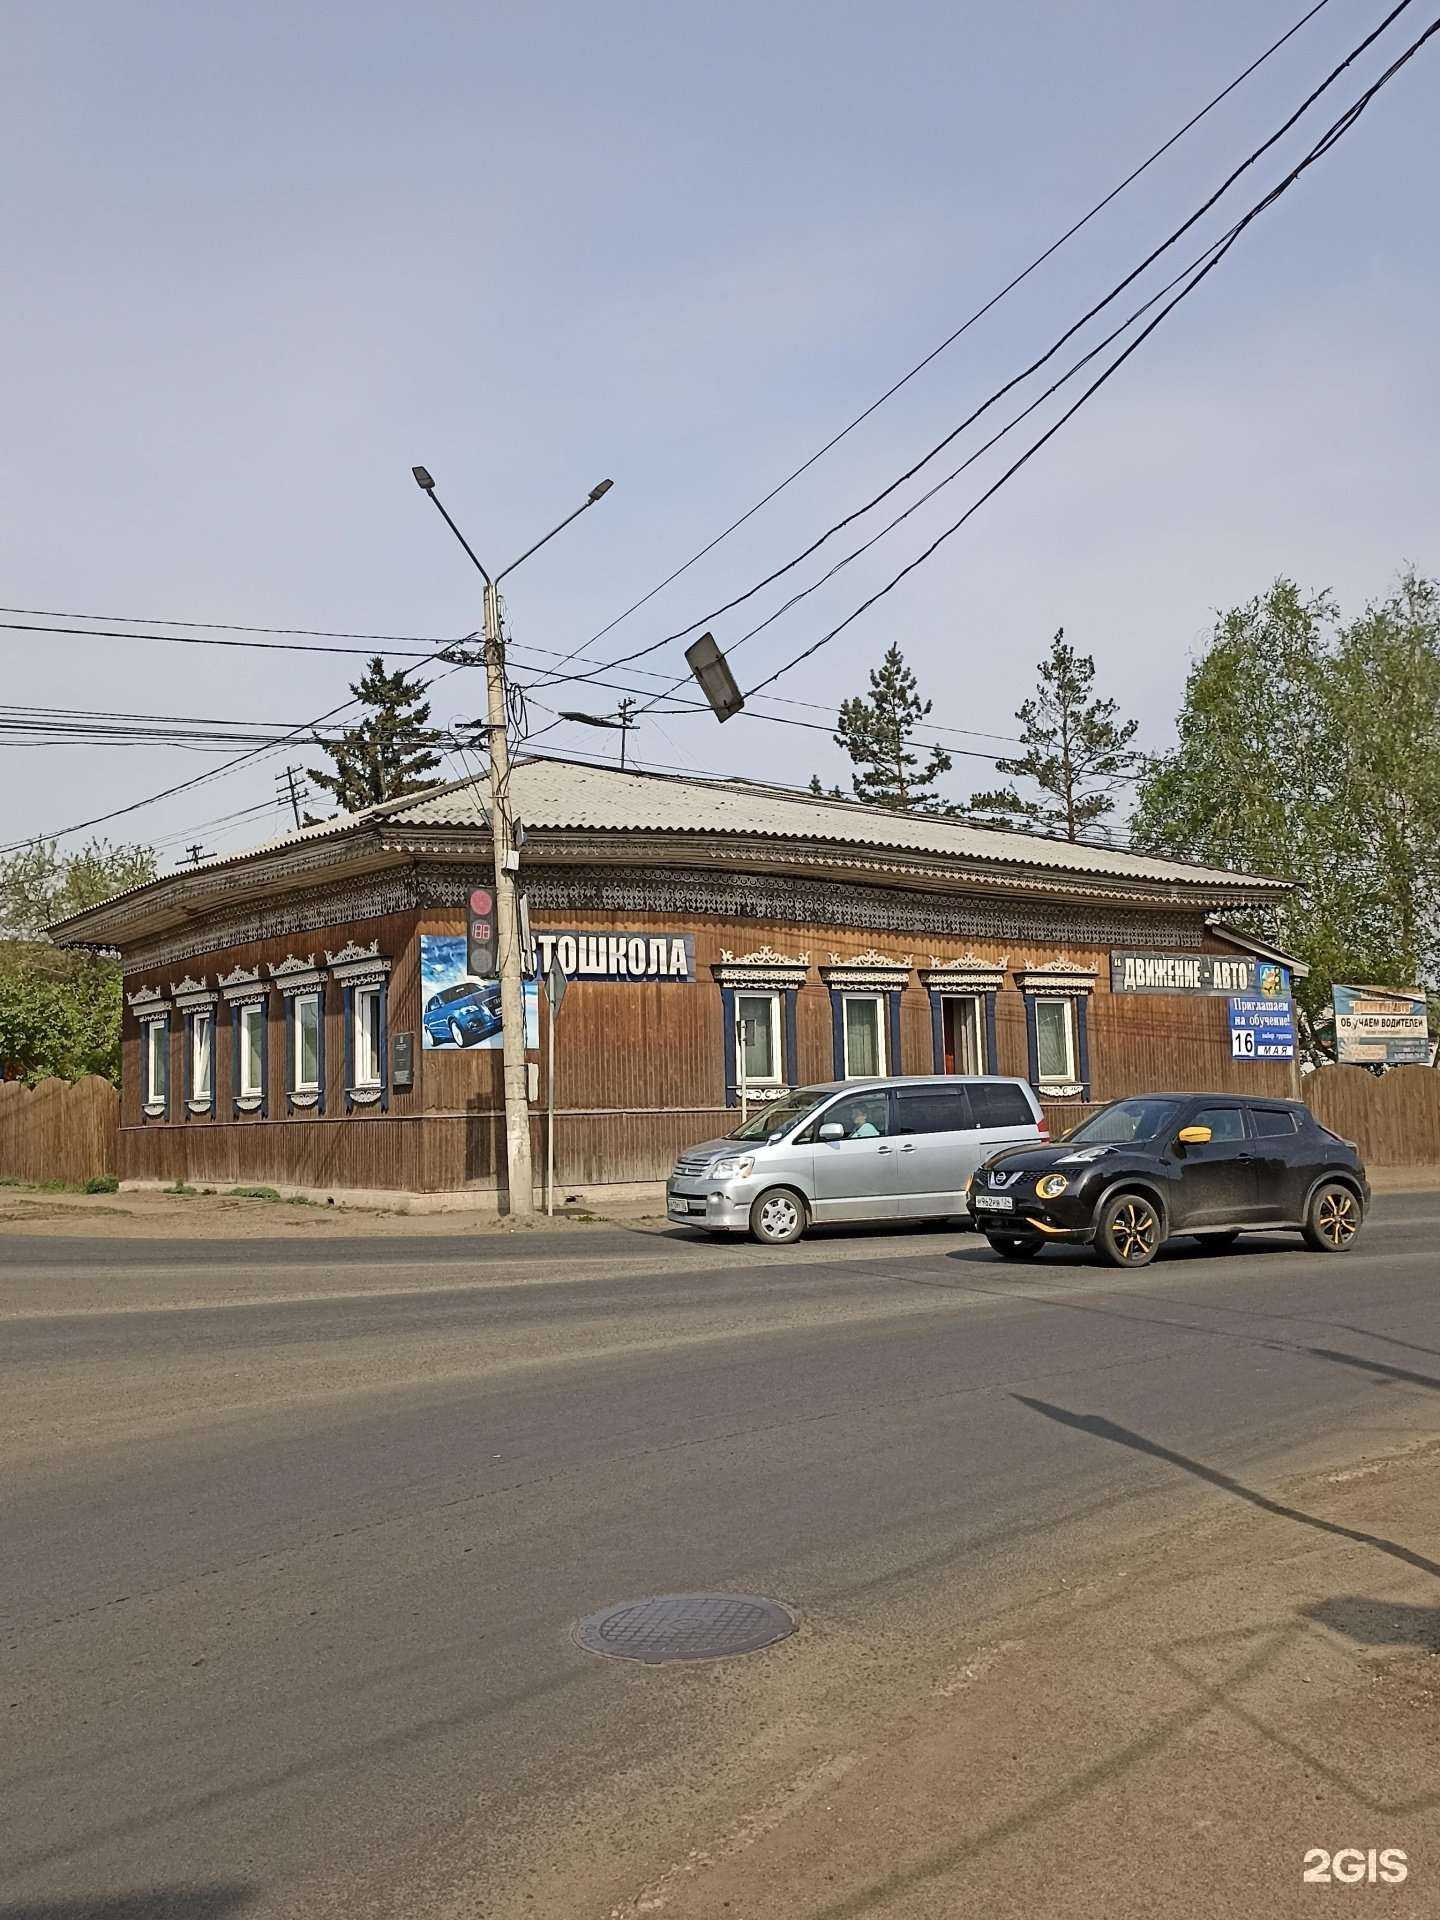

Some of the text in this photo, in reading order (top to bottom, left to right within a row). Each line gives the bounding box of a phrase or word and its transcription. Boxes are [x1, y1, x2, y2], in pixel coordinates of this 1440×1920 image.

[496, 935, 689, 976] ВТОШКОЛА
[1233, 997, 1289, 1013] Приглашаем
[1234, 1013, 1290, 1028] на обучение!
[1235, 1032, 1253, 1053] 16
[1263, 1046, 1288, 1055] МАЯ
